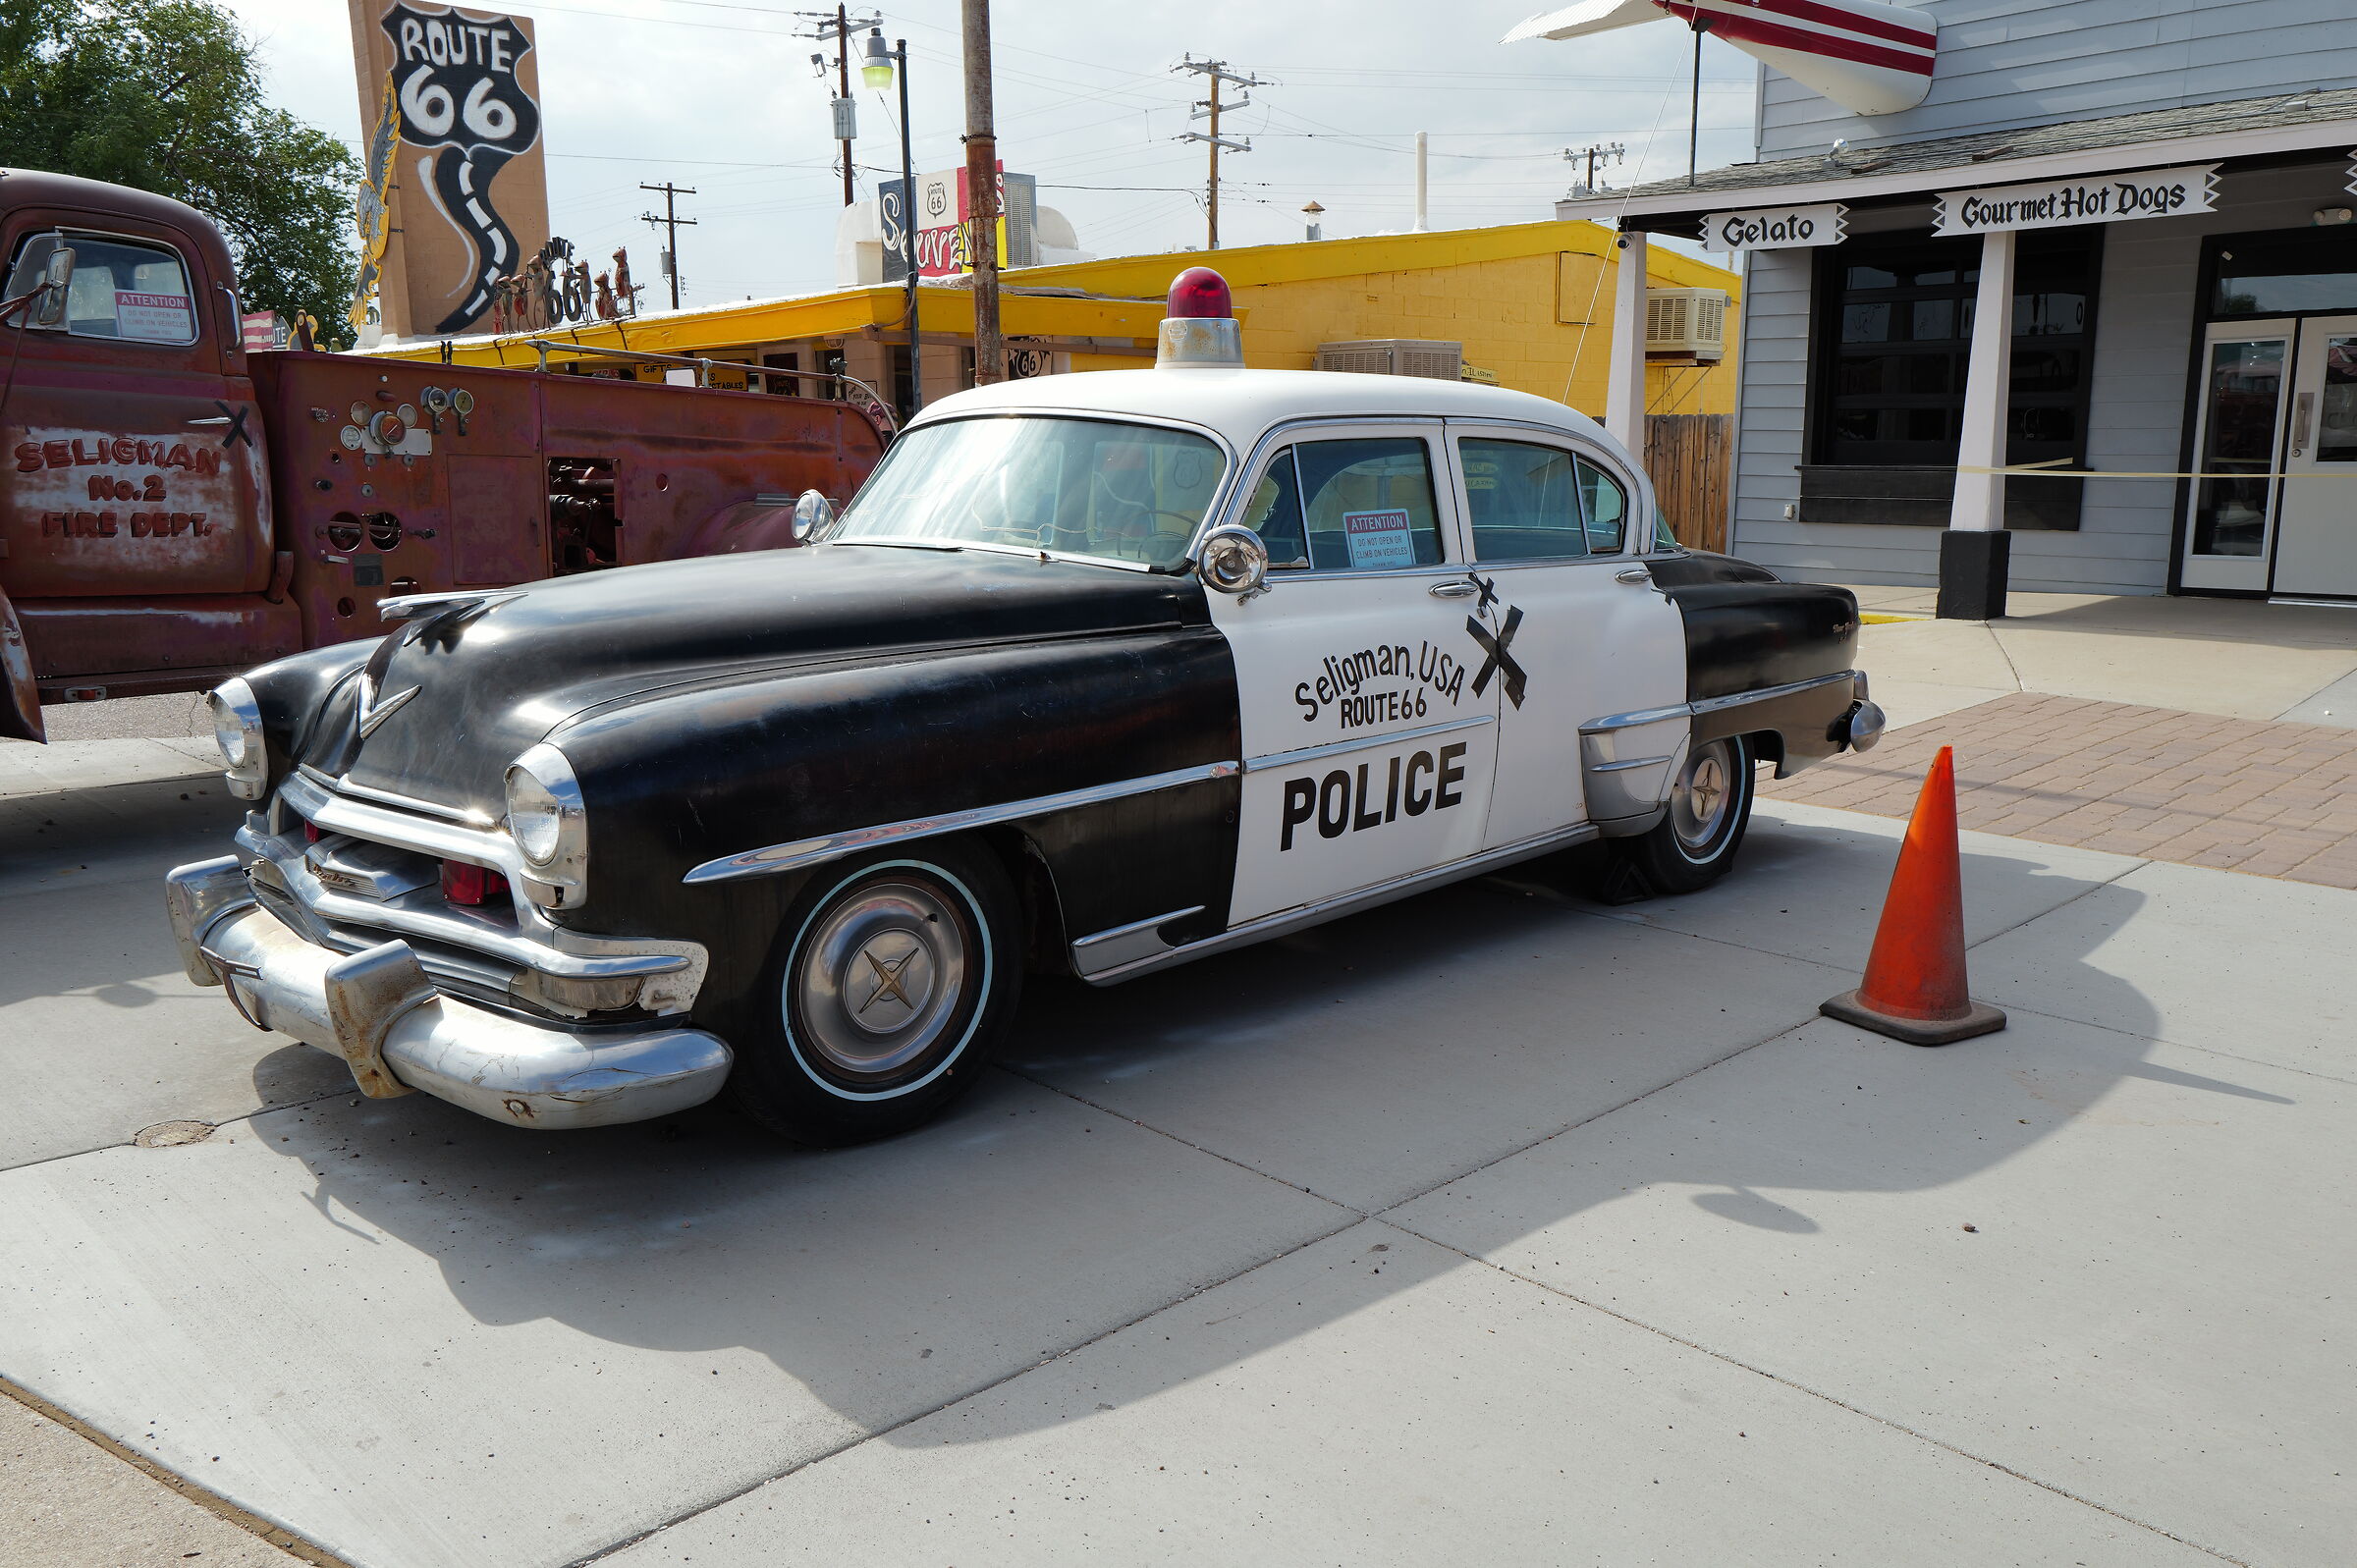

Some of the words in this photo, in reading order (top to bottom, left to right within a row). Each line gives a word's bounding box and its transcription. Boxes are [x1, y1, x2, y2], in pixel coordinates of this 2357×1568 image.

[401, 17, 512, 74] ROUTE
[401, 64, 518, 140] 66
[931, 196, 942, 209] 66
[1961, 192, 2056, 228] Gourmet
[2056, 186, 2110, 221] Hot
[2111, 182, 2186, 215] Dogs
[1722, 213, 1814, 247] Gelato
[121, 295, 186, 307] ATTENTION
[545, 267, 581, 324] 66
[1021, 354, 1036, 372] 66
[15, 438, 221, 475] SELIGMAN
[42, 512, 118, 538] FIRE
[131, 512, 212, 538] DEPT.
[1351, 515, 1403, 530] ATTENTION
[1379, 536, 1393, 545] OPEN
[1395, 535, 1402, 544] OR
[1374, 549, 1382, 558] ON
[1383, 547, 1407, 557] VEHICLES
[1294, 645, 1414, 722] Seligman,
[1418, 640, 1465, 706] USA
[1341, 691, 1398, 730] ROUTE
[1400, 687, 1427, 720] 66
[1280, 741, 1467, 852] POLICE
